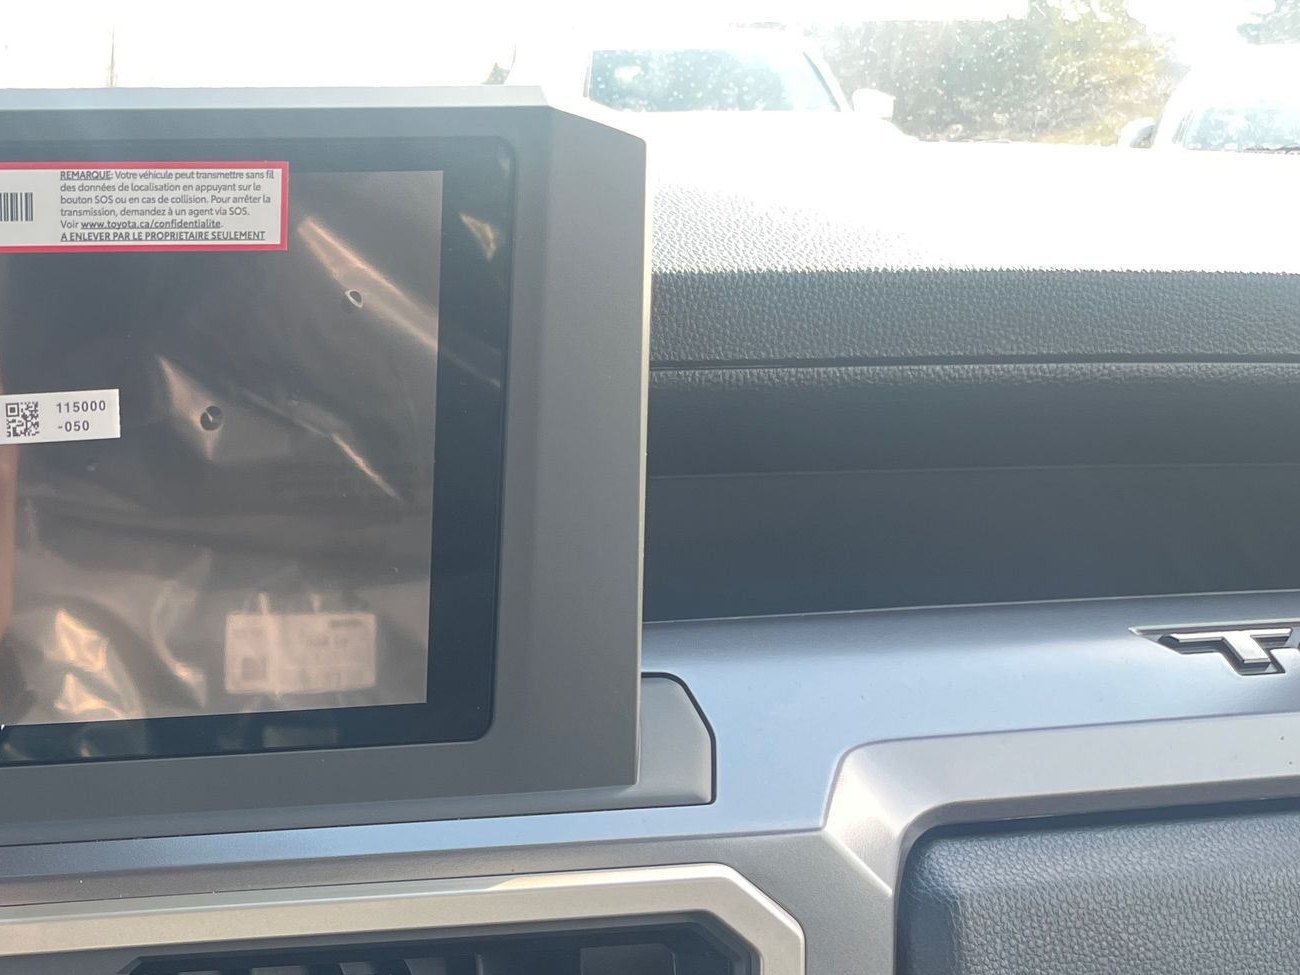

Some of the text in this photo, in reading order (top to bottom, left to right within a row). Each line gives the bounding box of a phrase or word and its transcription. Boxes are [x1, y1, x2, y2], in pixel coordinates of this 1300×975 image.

[60, 171, 113, 180] REMARQUE:
[115, 171, 138, 179] Votre
[139, 170, 173, 179] véhicule
[175, 171, 194, 180] peut
[196, 171, 244, 179] transmettre
[266, 170, 274, 179] fil
[60, 183, 76, 192] des
[78, 183, 116, 192] données
[118, 183, 129, 191] de
[131, 183, 180, 191] localisation
[195, 183, 236, 193] appuyant
[253, 183, 261, 191] le
[60, 196, 92, 204] bouton
[95, 195, 113, 204] SOS
[158, 195, 169, 203] de
[171, 195, 208, 203] collision.
[211, 195, 231, 203] Pour
[232, 195, 261, 203] arrêter
[263, 195, 271, 203] la
[60, 208, 118, 217] transmission,
[120, 207, 166, 216] demandez
[168, 207, 172, 215] à
[188, 208, 213, 217] agent
[215, 207, 227, 215] via
[229, 207, 250, 215] SOS.
[60, 219, 224, 230] Voir www.toyota.ca/confidentialite.
[60, 231, 266, 241] A ENLEVER PAR LE PROPRIETAIRE SEULEMENT
[56, 400, 106, 413] 115000
[58, 420, 90, 432] -050
